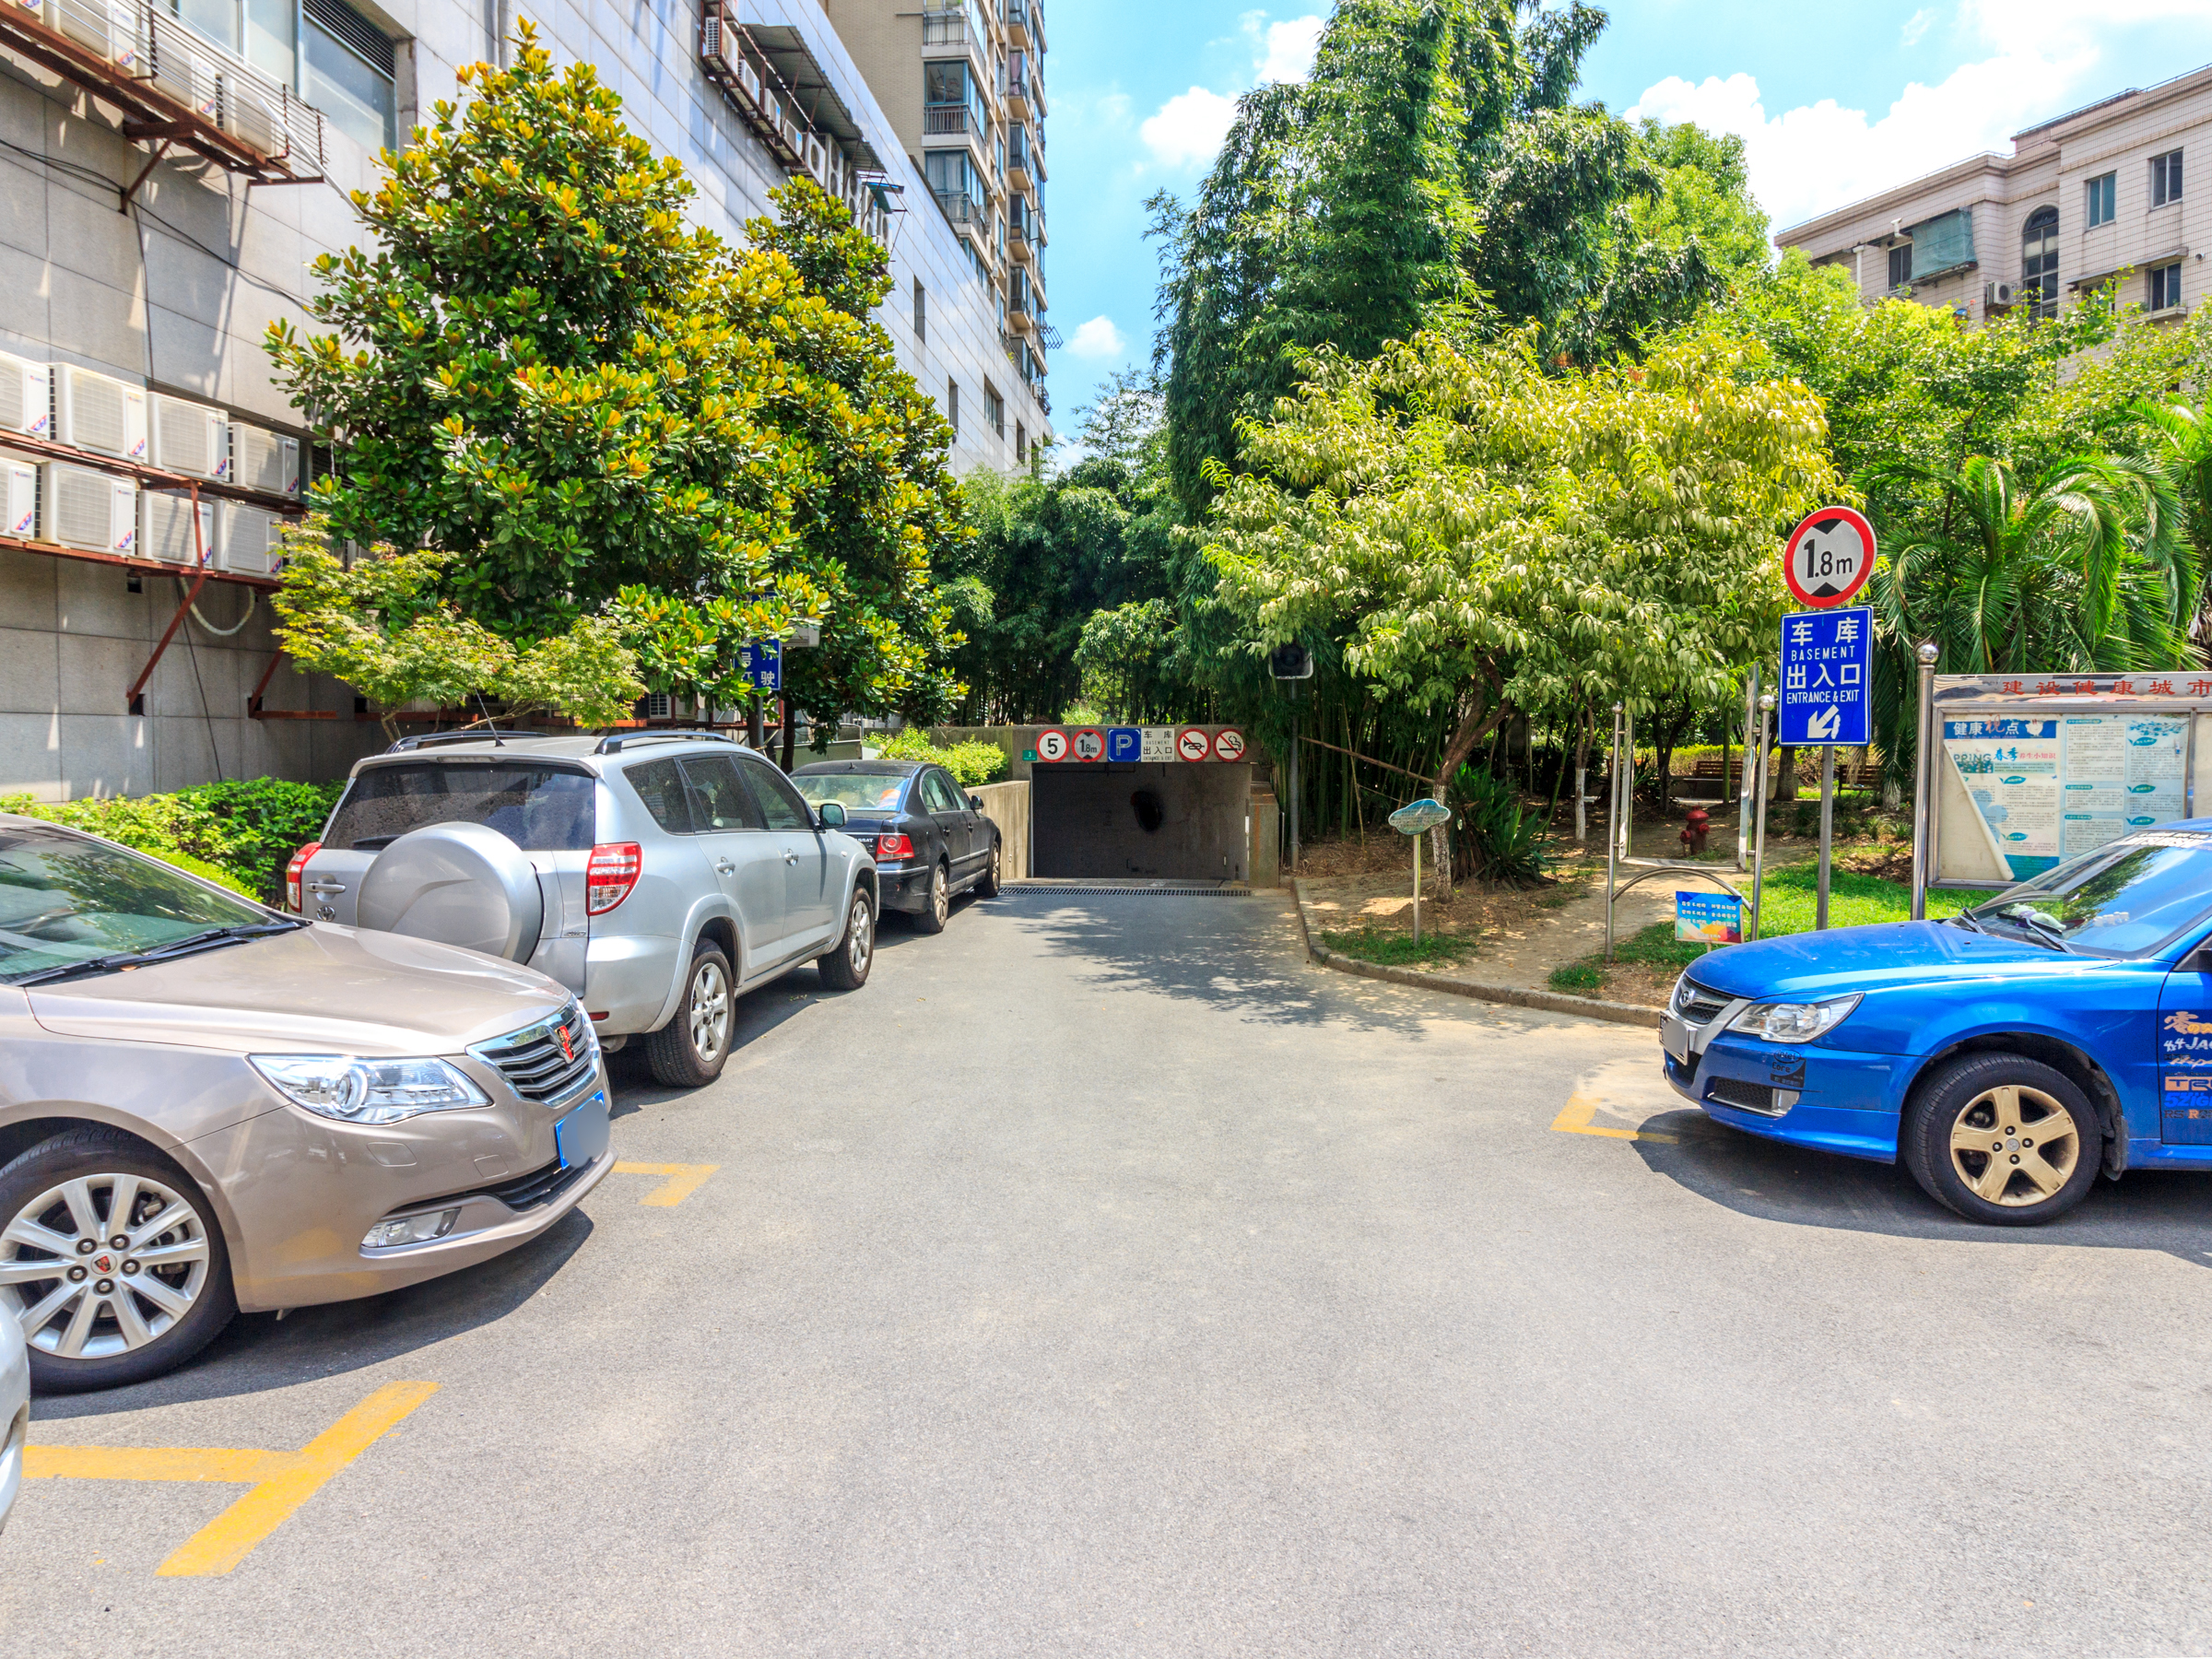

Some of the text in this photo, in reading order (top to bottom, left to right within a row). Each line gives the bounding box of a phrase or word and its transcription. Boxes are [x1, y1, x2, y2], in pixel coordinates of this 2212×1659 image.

[1804, 538, 1853, 579] 1.8m
[1790, 617, 1860, 646] 车库
[1791, 645, 1855, 661] BASEMENT
[1786, 663, 1860, 689] 出入口
[2001, 679, 2212, 696] 建设健康城市
[1786, 689, 1860, 704] ENTRANCE & EXIT
[1144, 730, 1172, 738] 车库
[1047, 738, 1058, 755] 5
[1079, 738, 1098, 753] 1.8m
[1116, 735, 1133, 756] P
[1143, 746, 1172, 755] 出入口
[1771, 1061, 1791, 1073] Core
